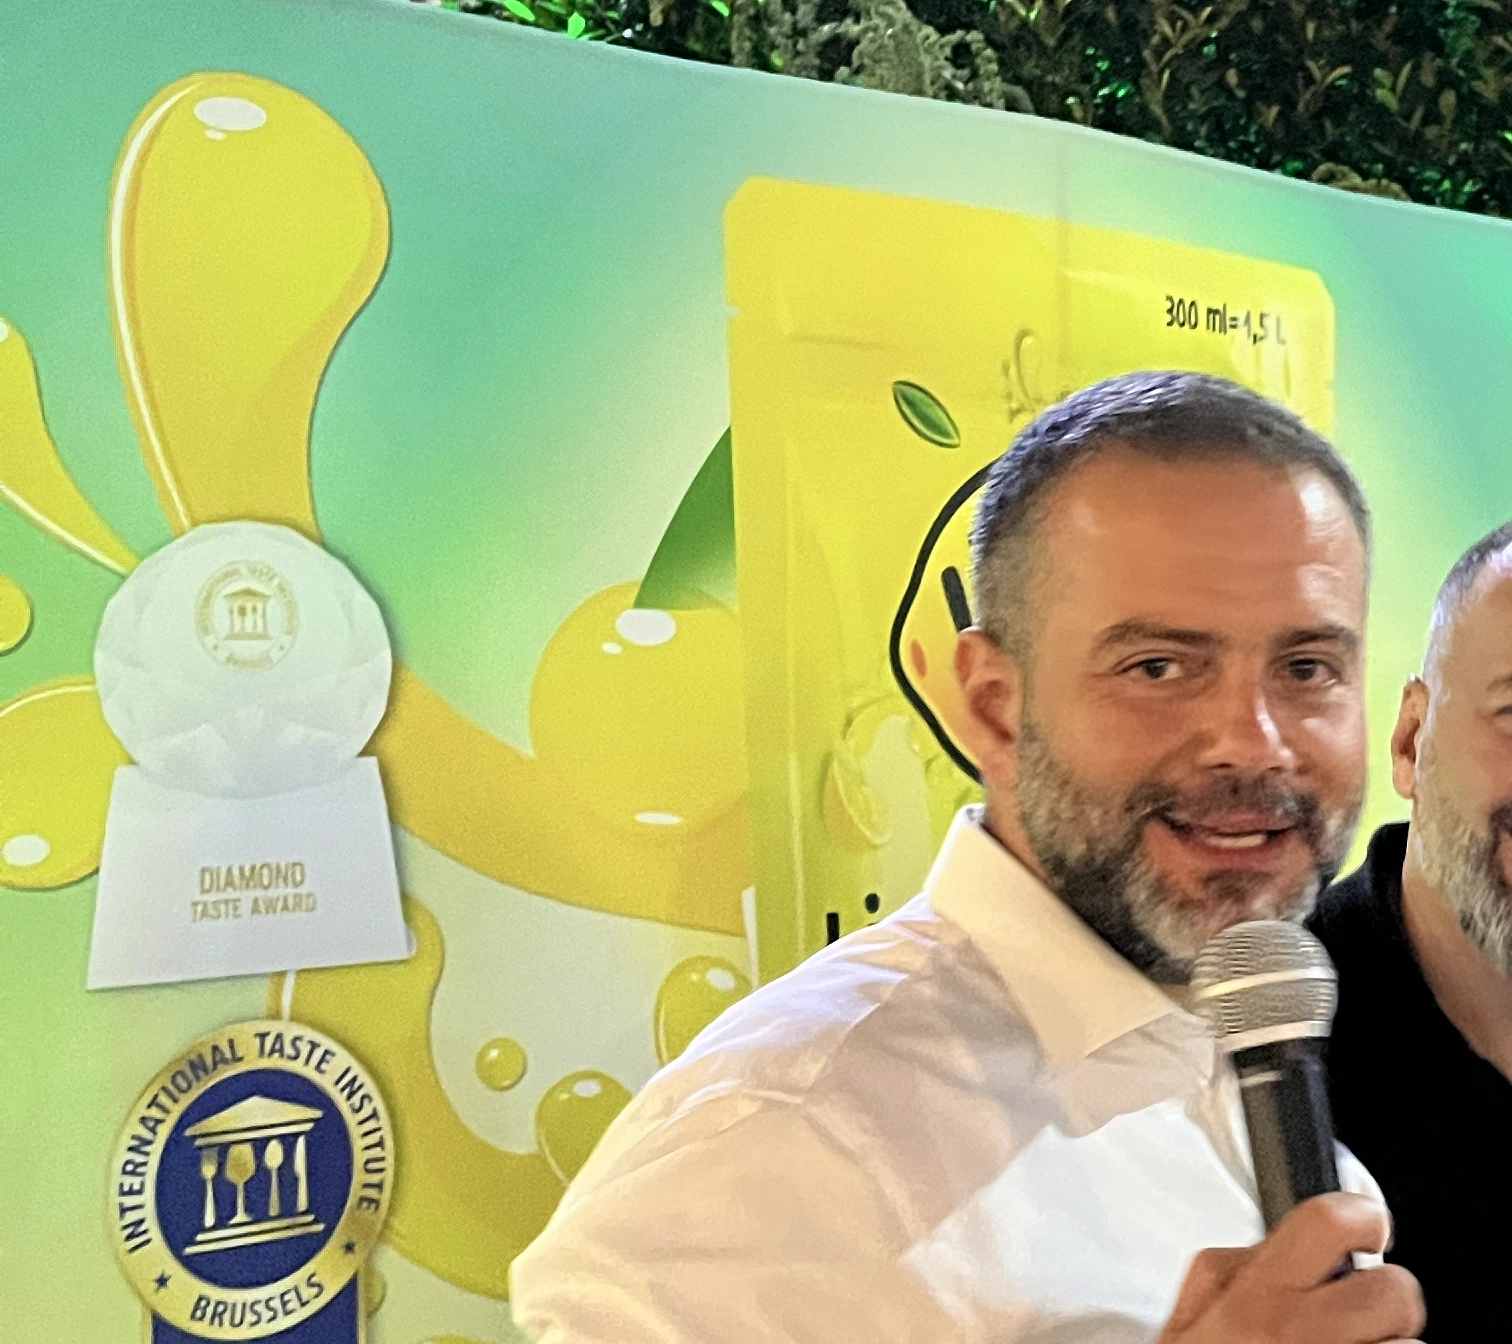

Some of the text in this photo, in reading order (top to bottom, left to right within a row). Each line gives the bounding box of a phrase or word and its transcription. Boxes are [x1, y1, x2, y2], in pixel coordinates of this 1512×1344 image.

[1165, 294, 1199, 330] 300
[200, 861, 306, 895] DIAMOND
[191, 892, 317, 922] TASTE AWARD
[118, 1030, 387, 1254] INTERNATIONAL TASTE INSTITUTE
[190, 1272, 326, 1329] BRUSSELS
